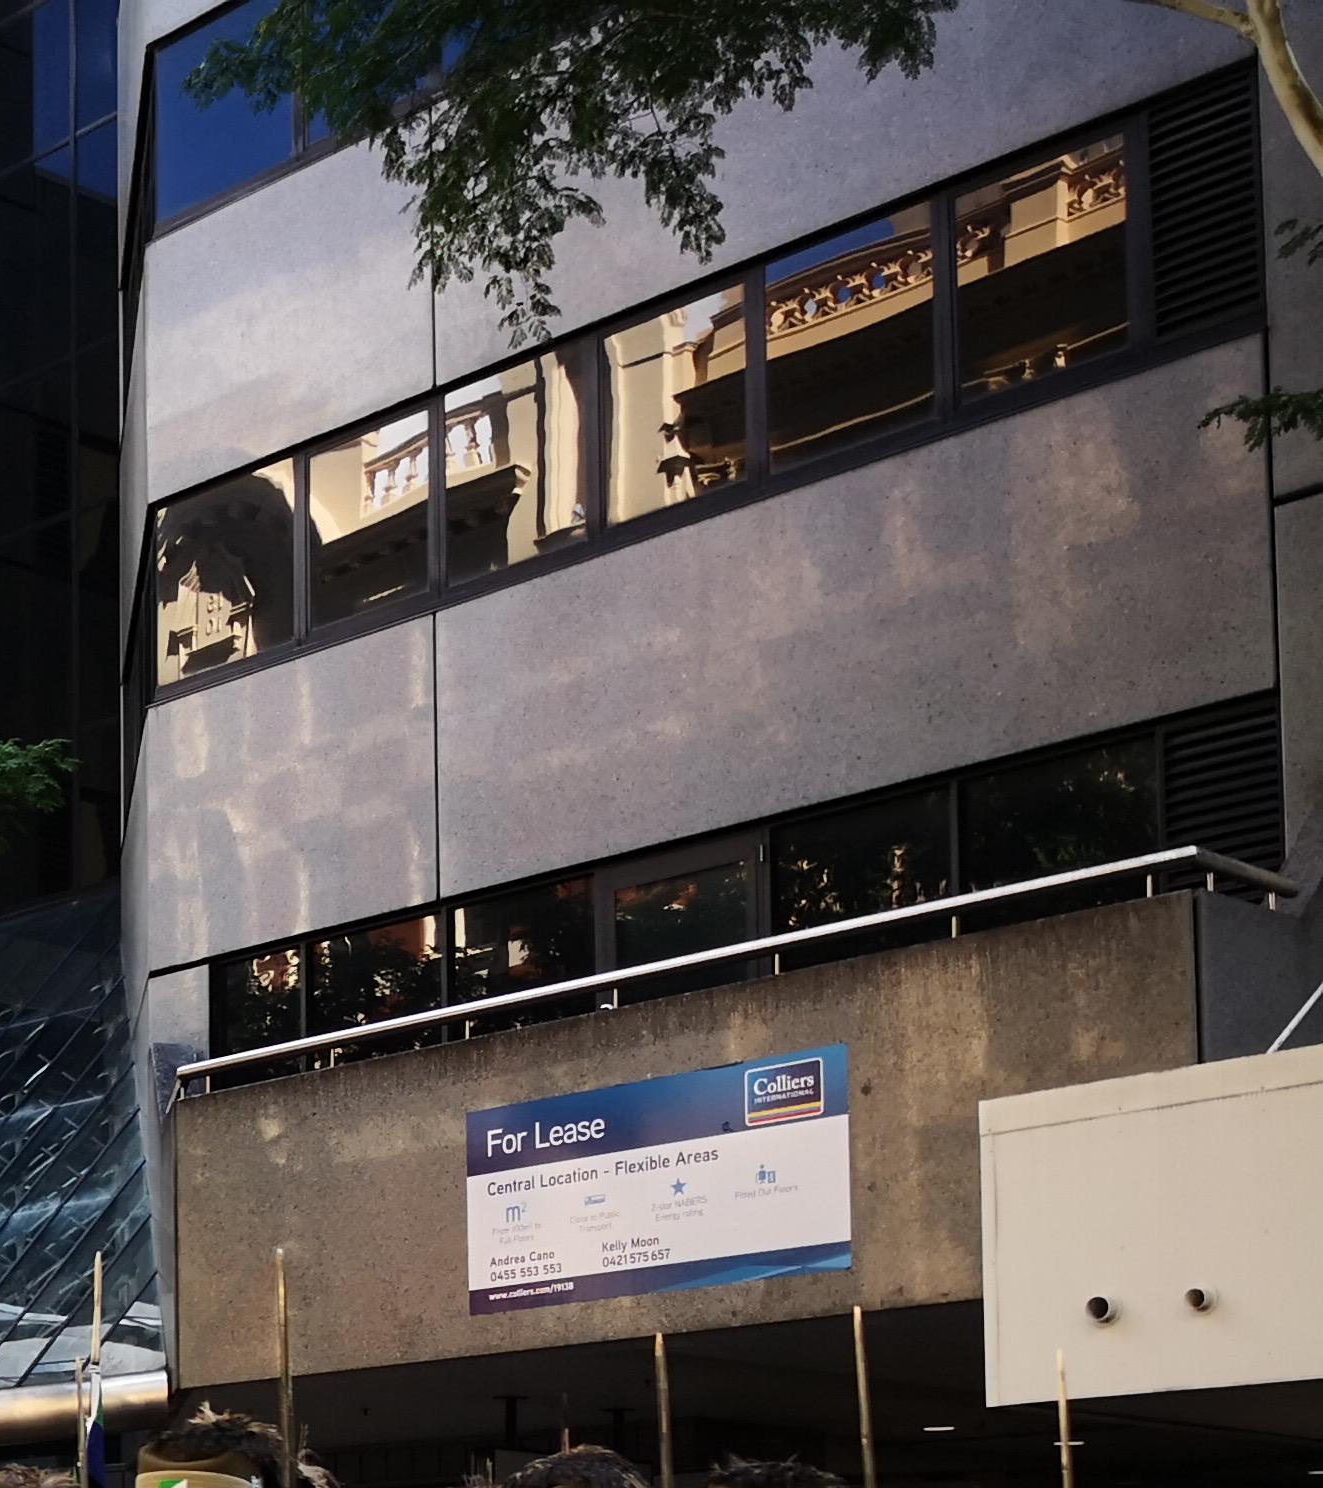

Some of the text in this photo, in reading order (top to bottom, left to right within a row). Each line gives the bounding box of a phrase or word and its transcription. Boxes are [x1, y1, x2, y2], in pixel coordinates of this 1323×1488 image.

[753, 1074, 815, 1095] Colliers
[754, 1088, 815, 1105] INTERNATIONAL
[487, 1119, 605, 1157] For Lease
[487, 1176, 535, 1196] Central
[540, 1168, 598, 1188] Location
[615, 1155, 670, 1175] Flexible
[675, 1150, 718, 1166] Areas
[602, 1234, 659, 1253] Kelly Moon
[490, 1249, 554, 1267] Andrea Cano
[489, 1261, 562, 1282] 0455 553 553
